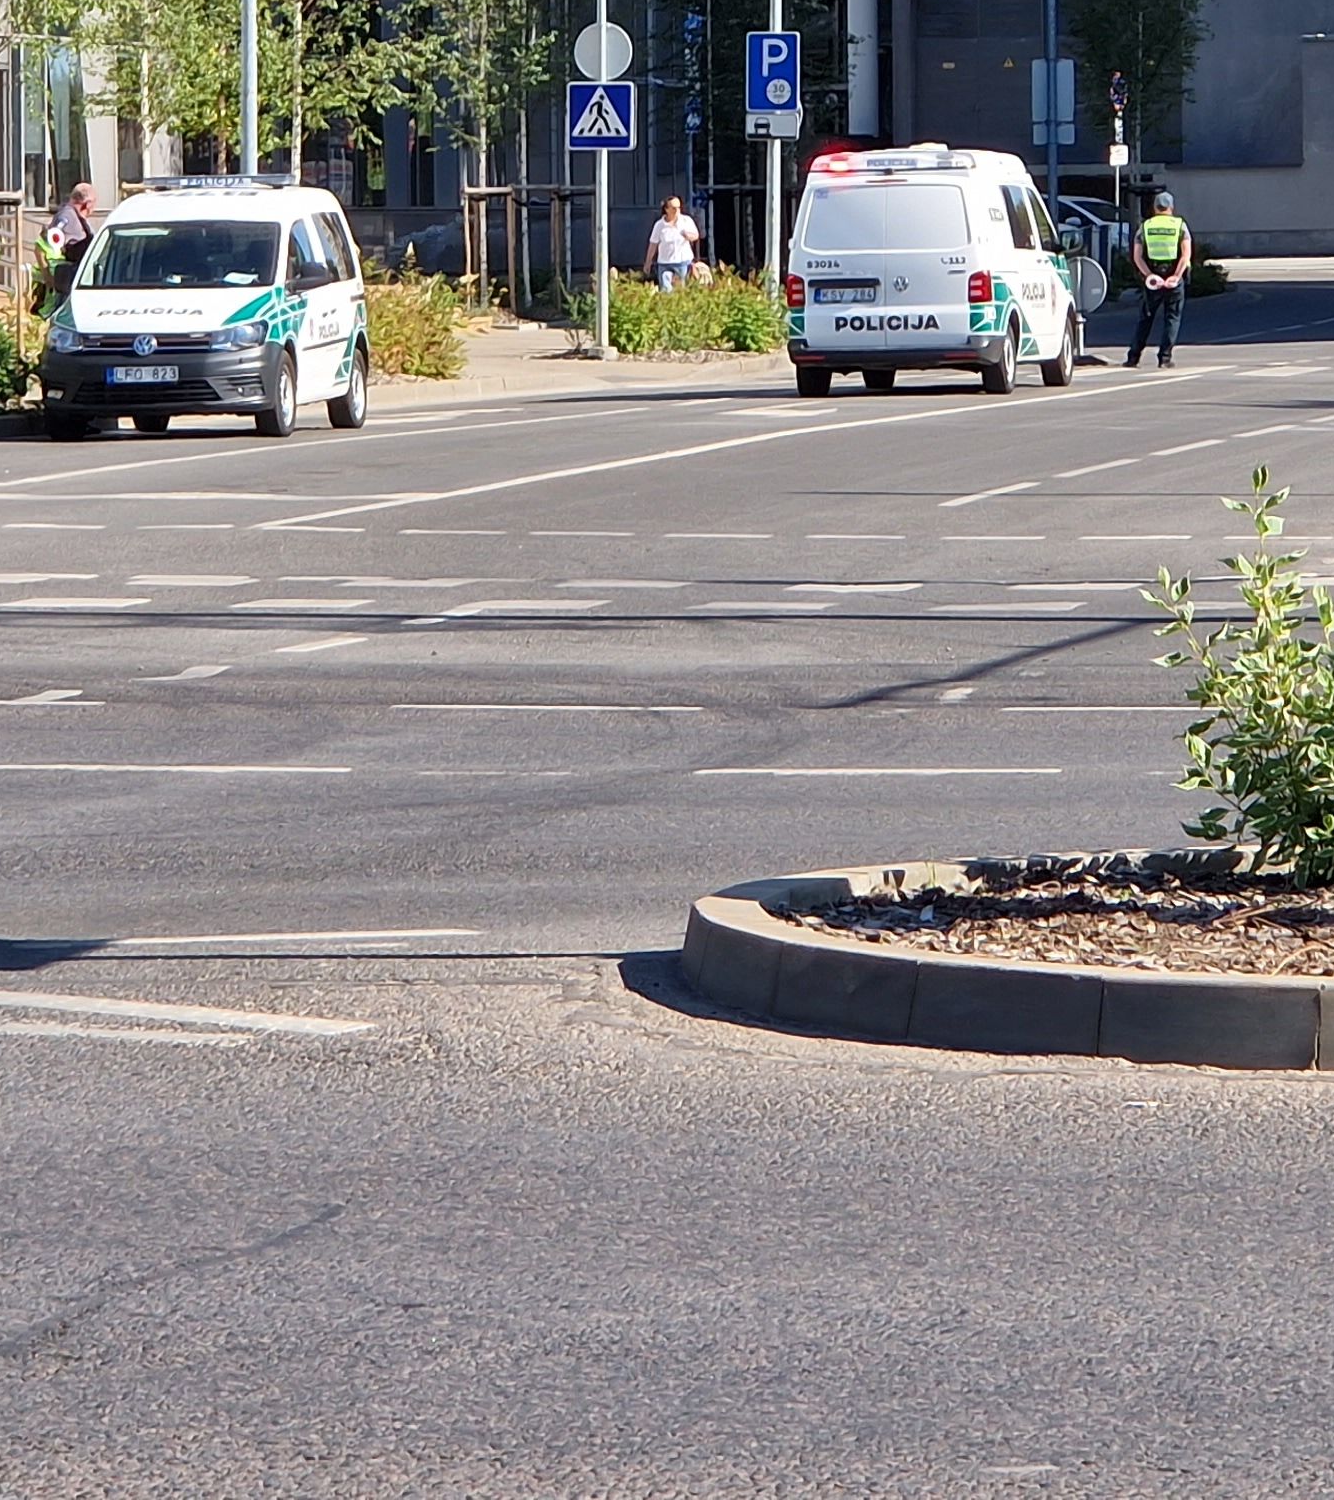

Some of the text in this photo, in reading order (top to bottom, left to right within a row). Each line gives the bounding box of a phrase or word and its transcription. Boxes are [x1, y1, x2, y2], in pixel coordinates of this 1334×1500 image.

[761, 38, 788, 77] P
[772, 83, 785, 94] 30
[97, 307, 203, 317] POLICIJA
[835, 314, 939, 332] POLICIJA
[152, 367, 177, 380] 823
